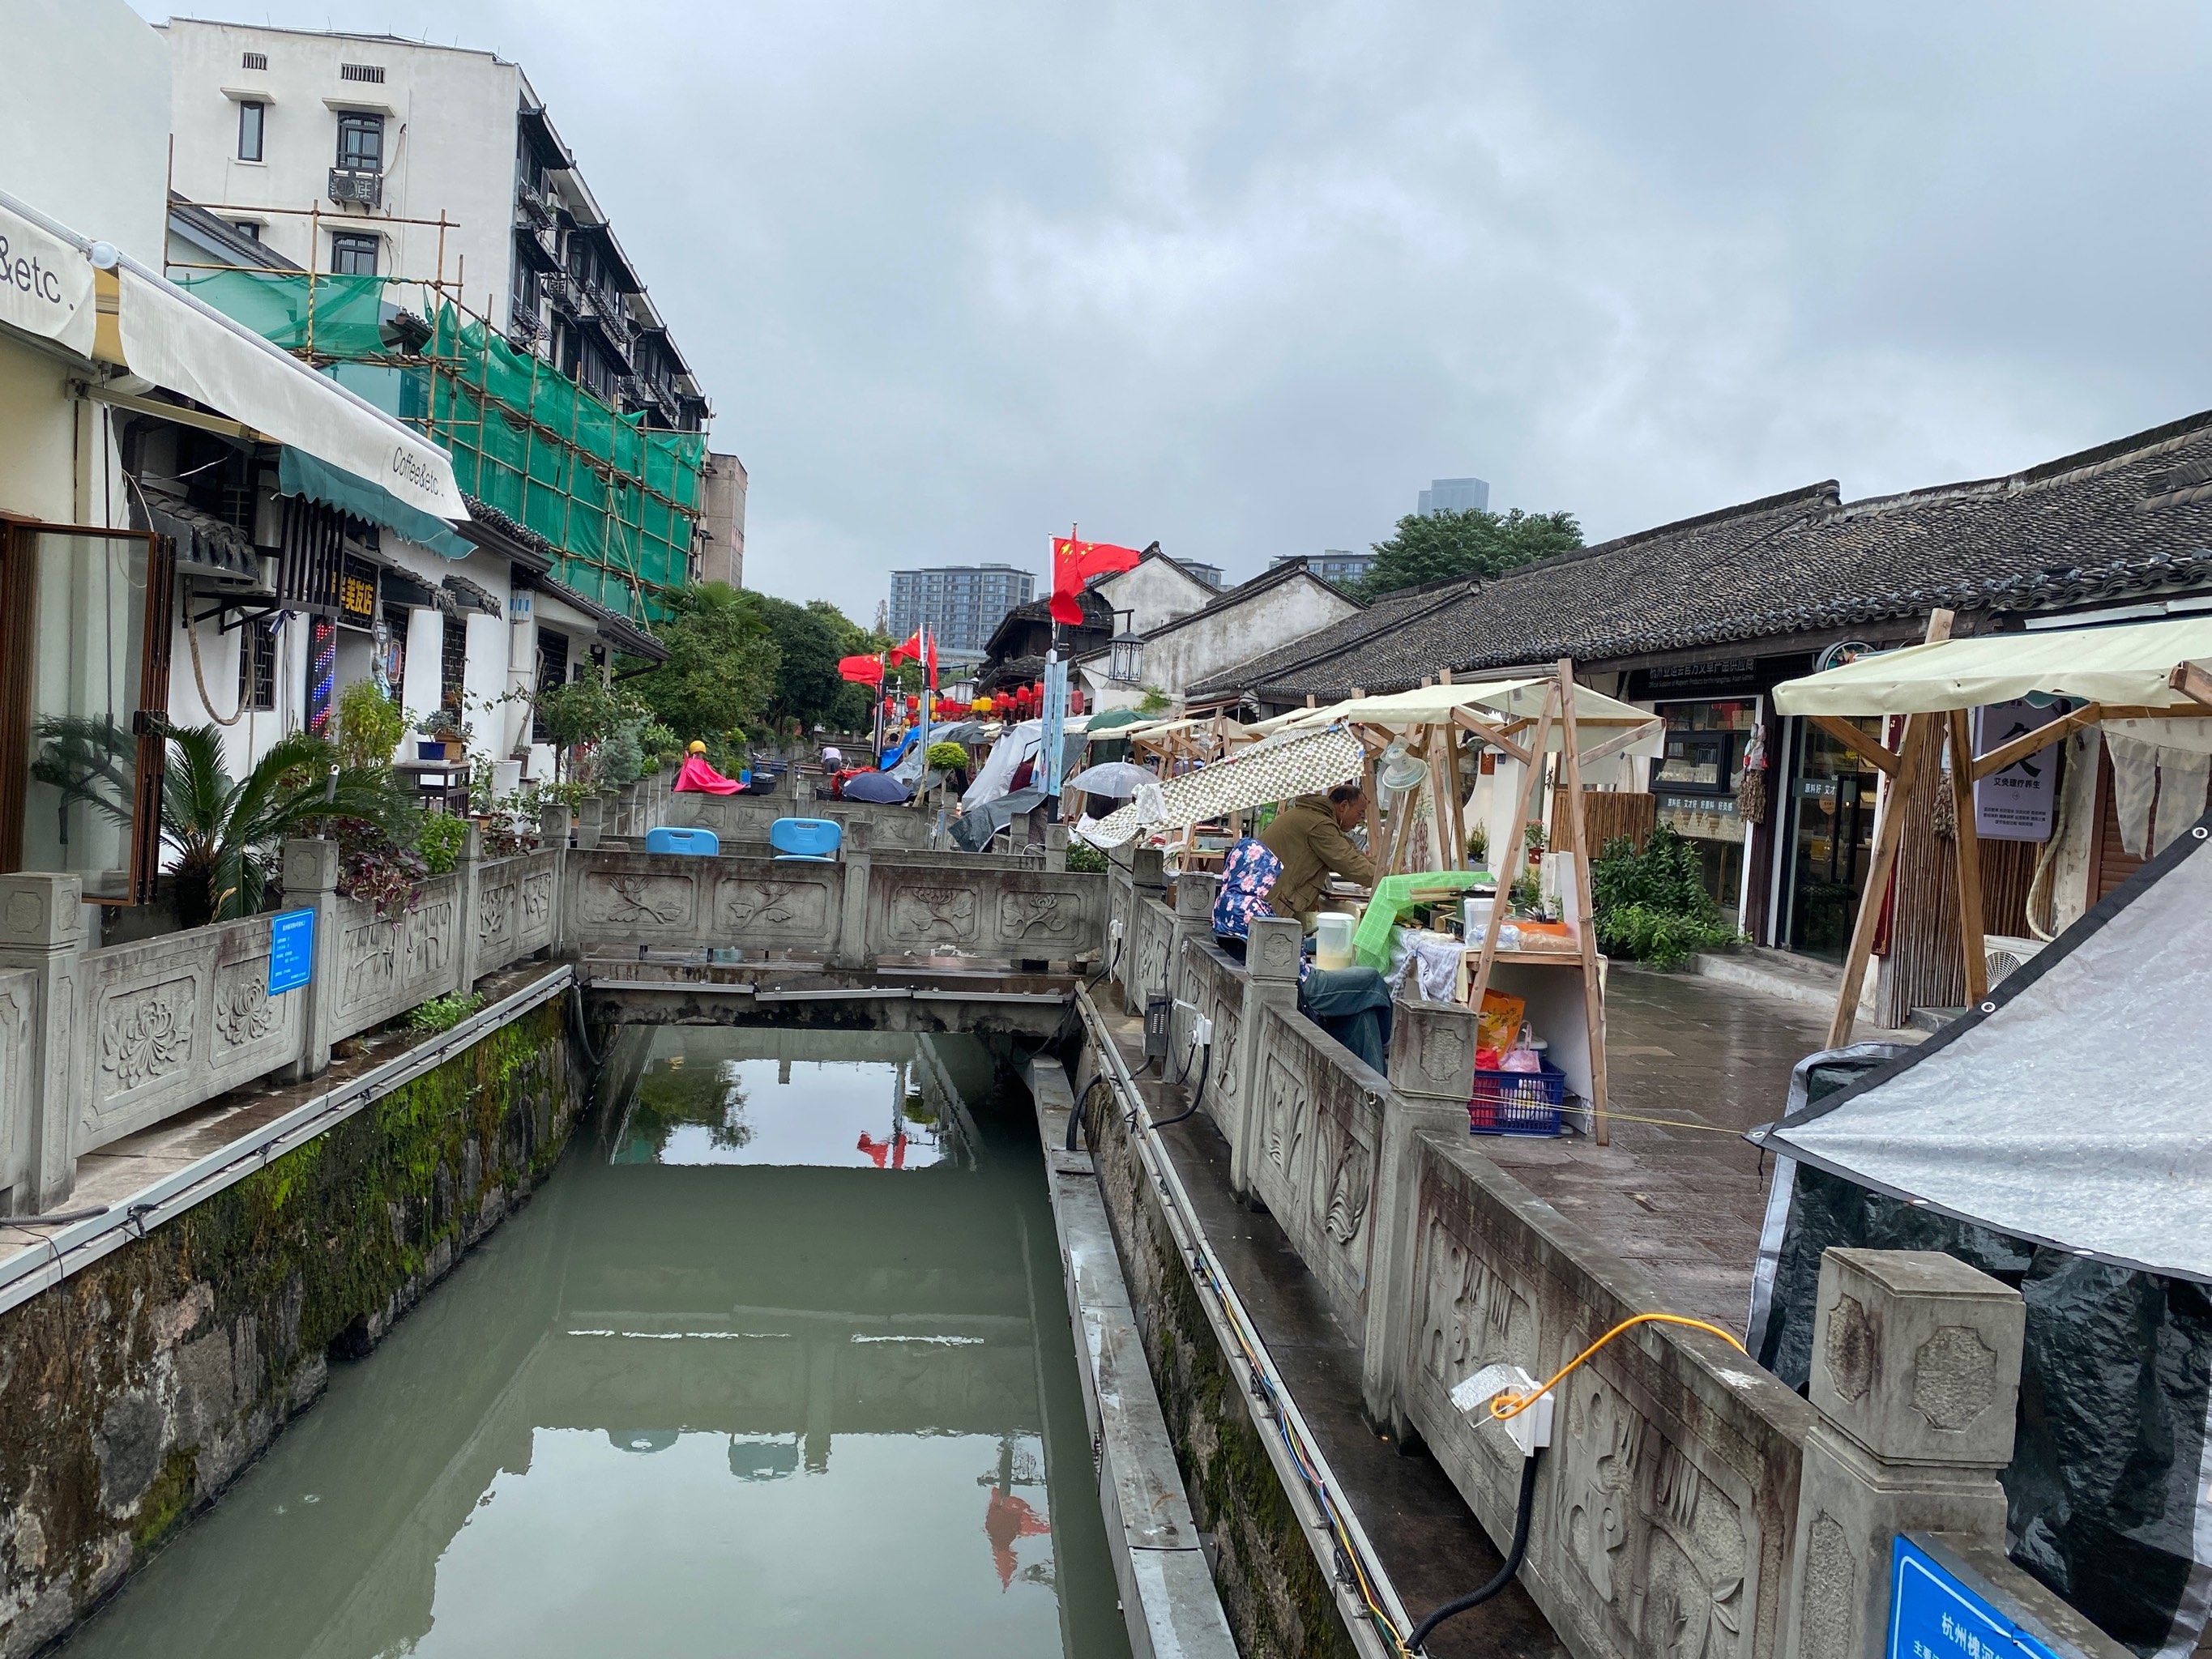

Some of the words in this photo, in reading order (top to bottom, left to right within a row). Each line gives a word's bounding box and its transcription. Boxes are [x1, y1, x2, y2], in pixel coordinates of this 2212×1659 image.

[1824, 784, 1836, 795] 艾才
[1941, 1611, 2004, 1659] 杭州槐河
